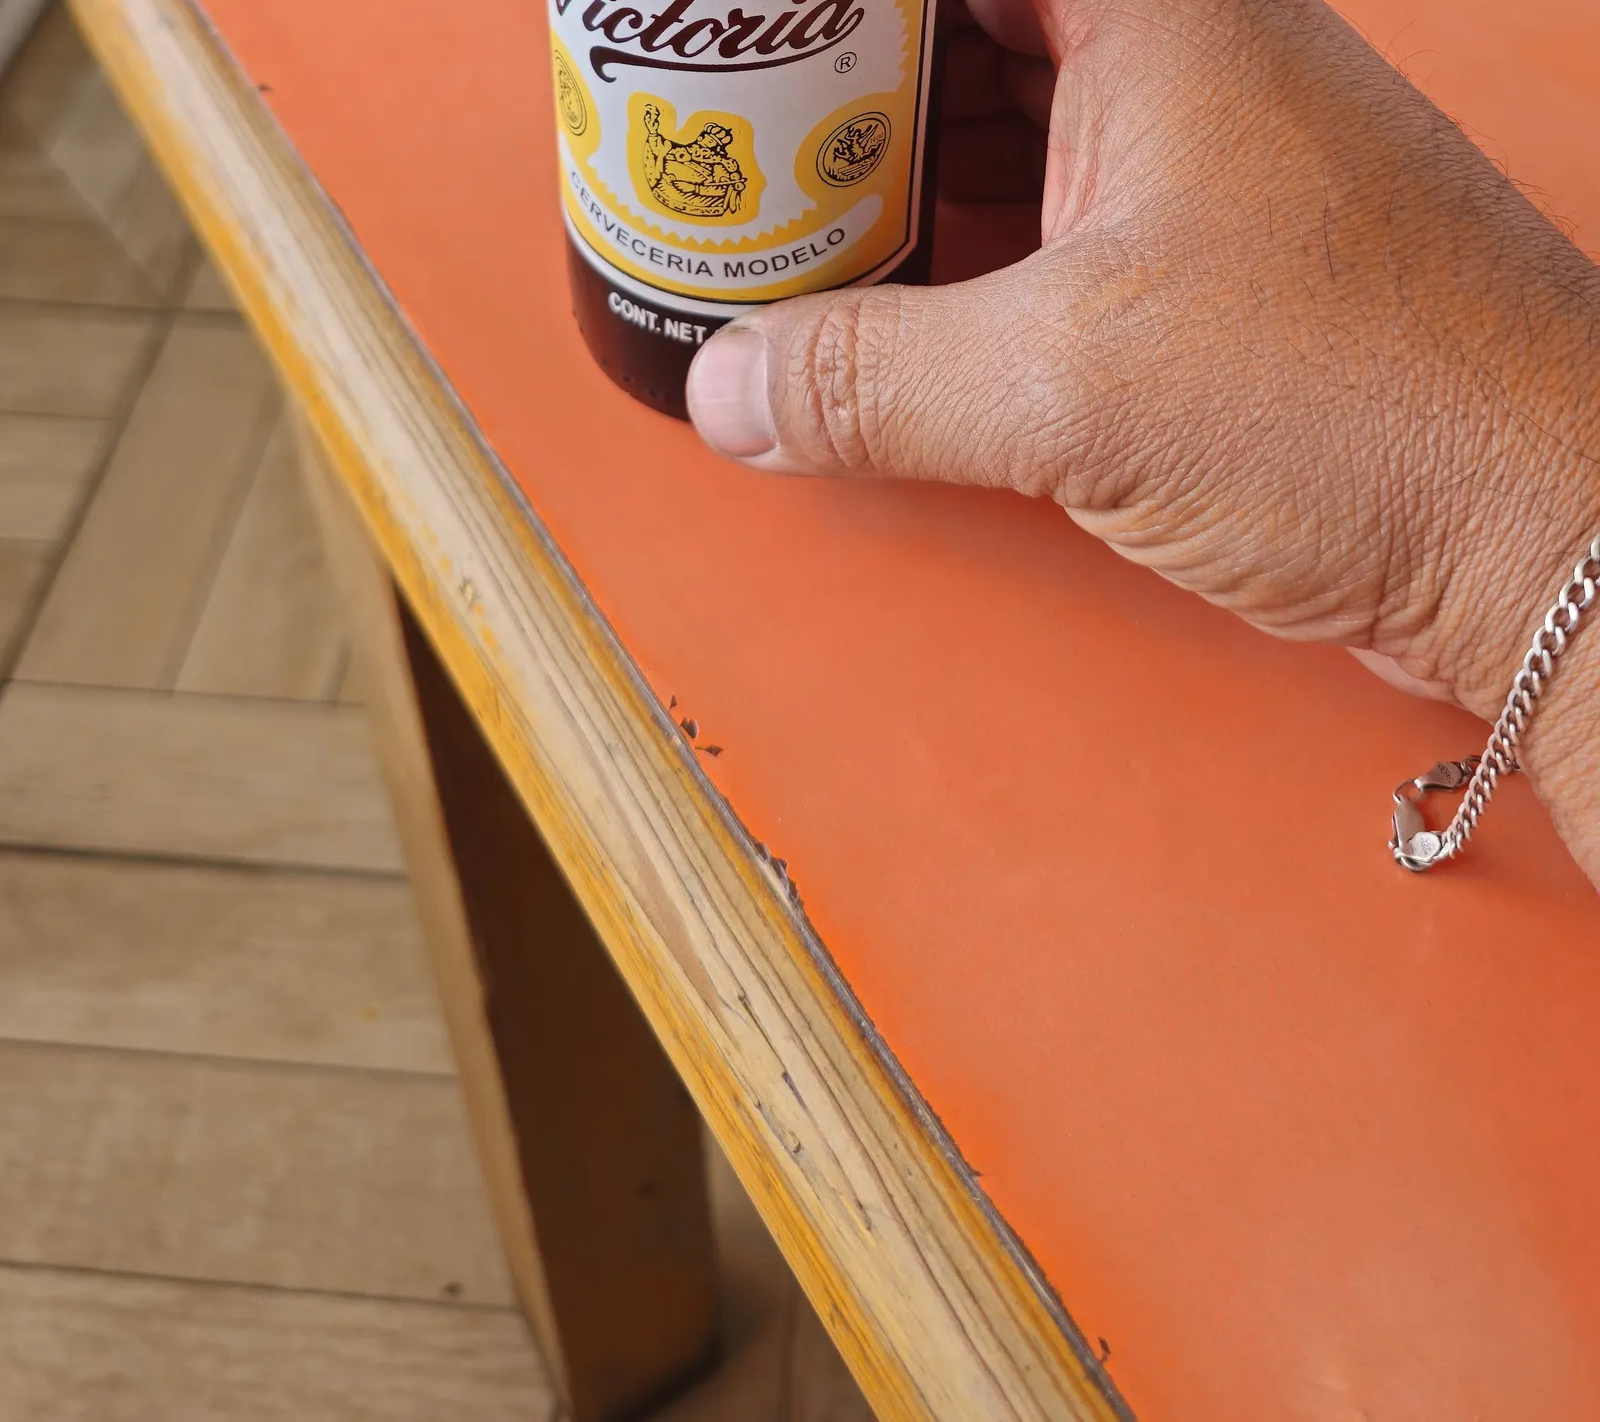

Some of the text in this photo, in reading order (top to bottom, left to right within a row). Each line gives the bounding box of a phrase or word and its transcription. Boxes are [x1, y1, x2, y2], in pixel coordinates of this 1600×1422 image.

[571, 170, 846, 279] CERVECERIA MODELO
[607, 291, 662, 334] CONT.
